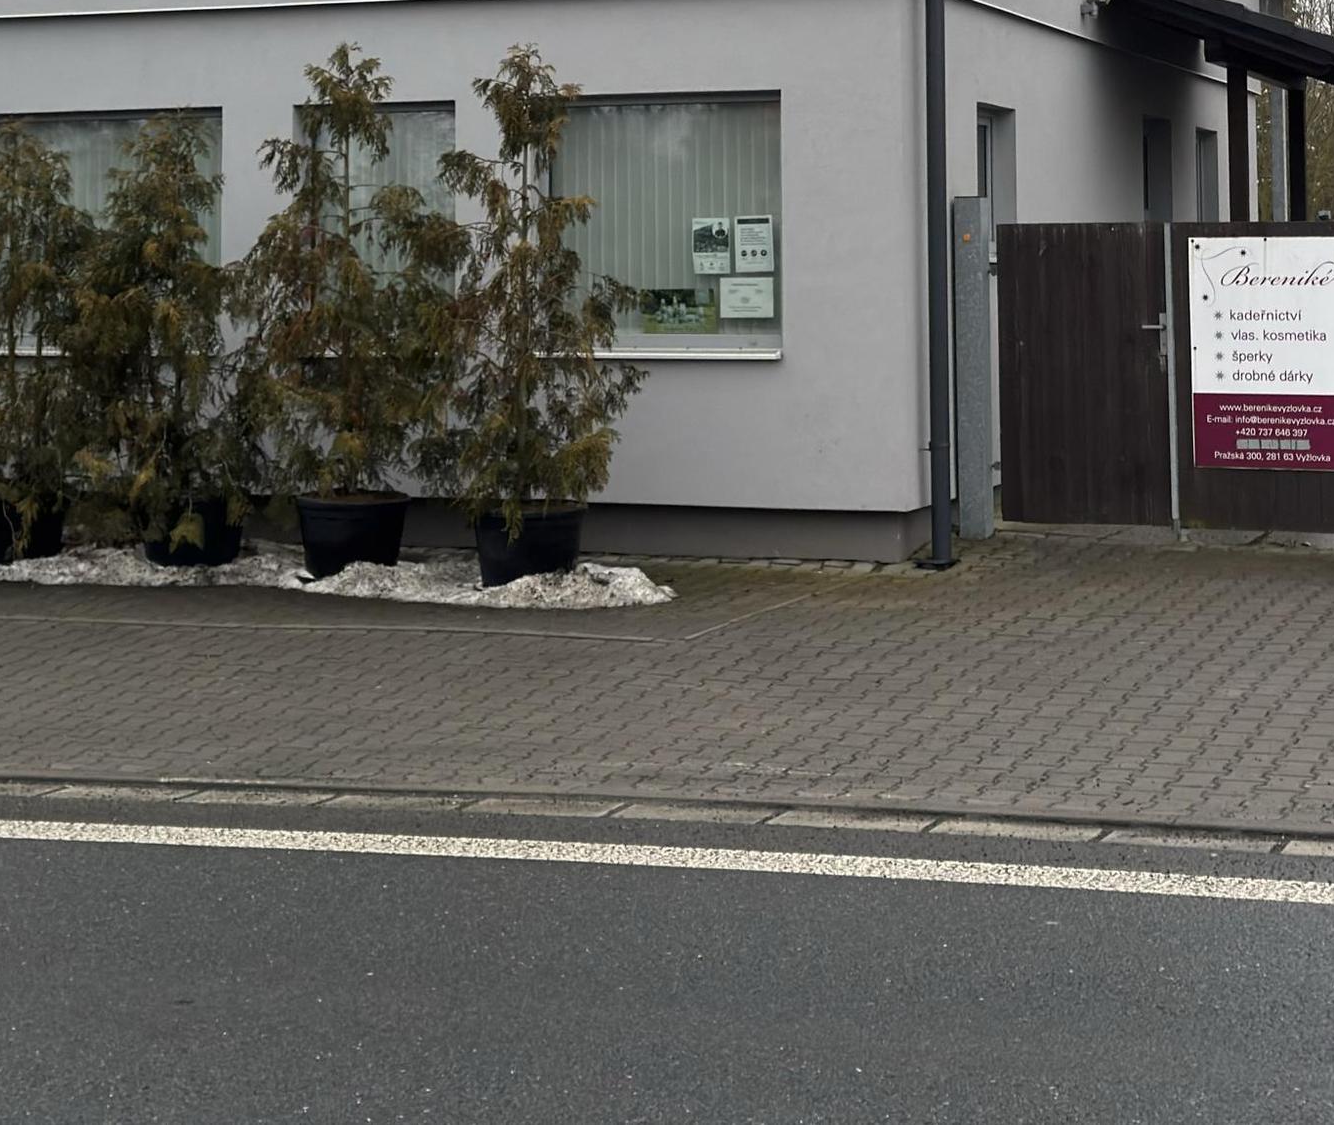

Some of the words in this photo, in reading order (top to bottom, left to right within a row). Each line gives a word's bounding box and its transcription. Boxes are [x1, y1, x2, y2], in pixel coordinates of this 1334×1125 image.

[1229, 309, 1302, 322] kadeřnictví
[1230, 330, 1259, 341] vlas.
[1263, 330, 1327, 342] kosmetika
[1232, 349, 1273, 364] šperky
[1232, 369, 1276, 382] drobné
[1279, 369, 1314, 384] dárky
[1219, 403, 1323, 414] www.berenikevyzlovka.cz
[1206, 415, 1233, 423] E-mail:
[1235, 428, 1256, 436] +420
[1258, 428, 1273, 437] 737
[1292, 429, 1308, 437] 397
[1214, 451, 1245, 461] Pražská
[1266, 452, 1281, 461] 281
[1283, 452, 1294, 461] 63
[1296, 452, 1331, 463] Vyžlovka
